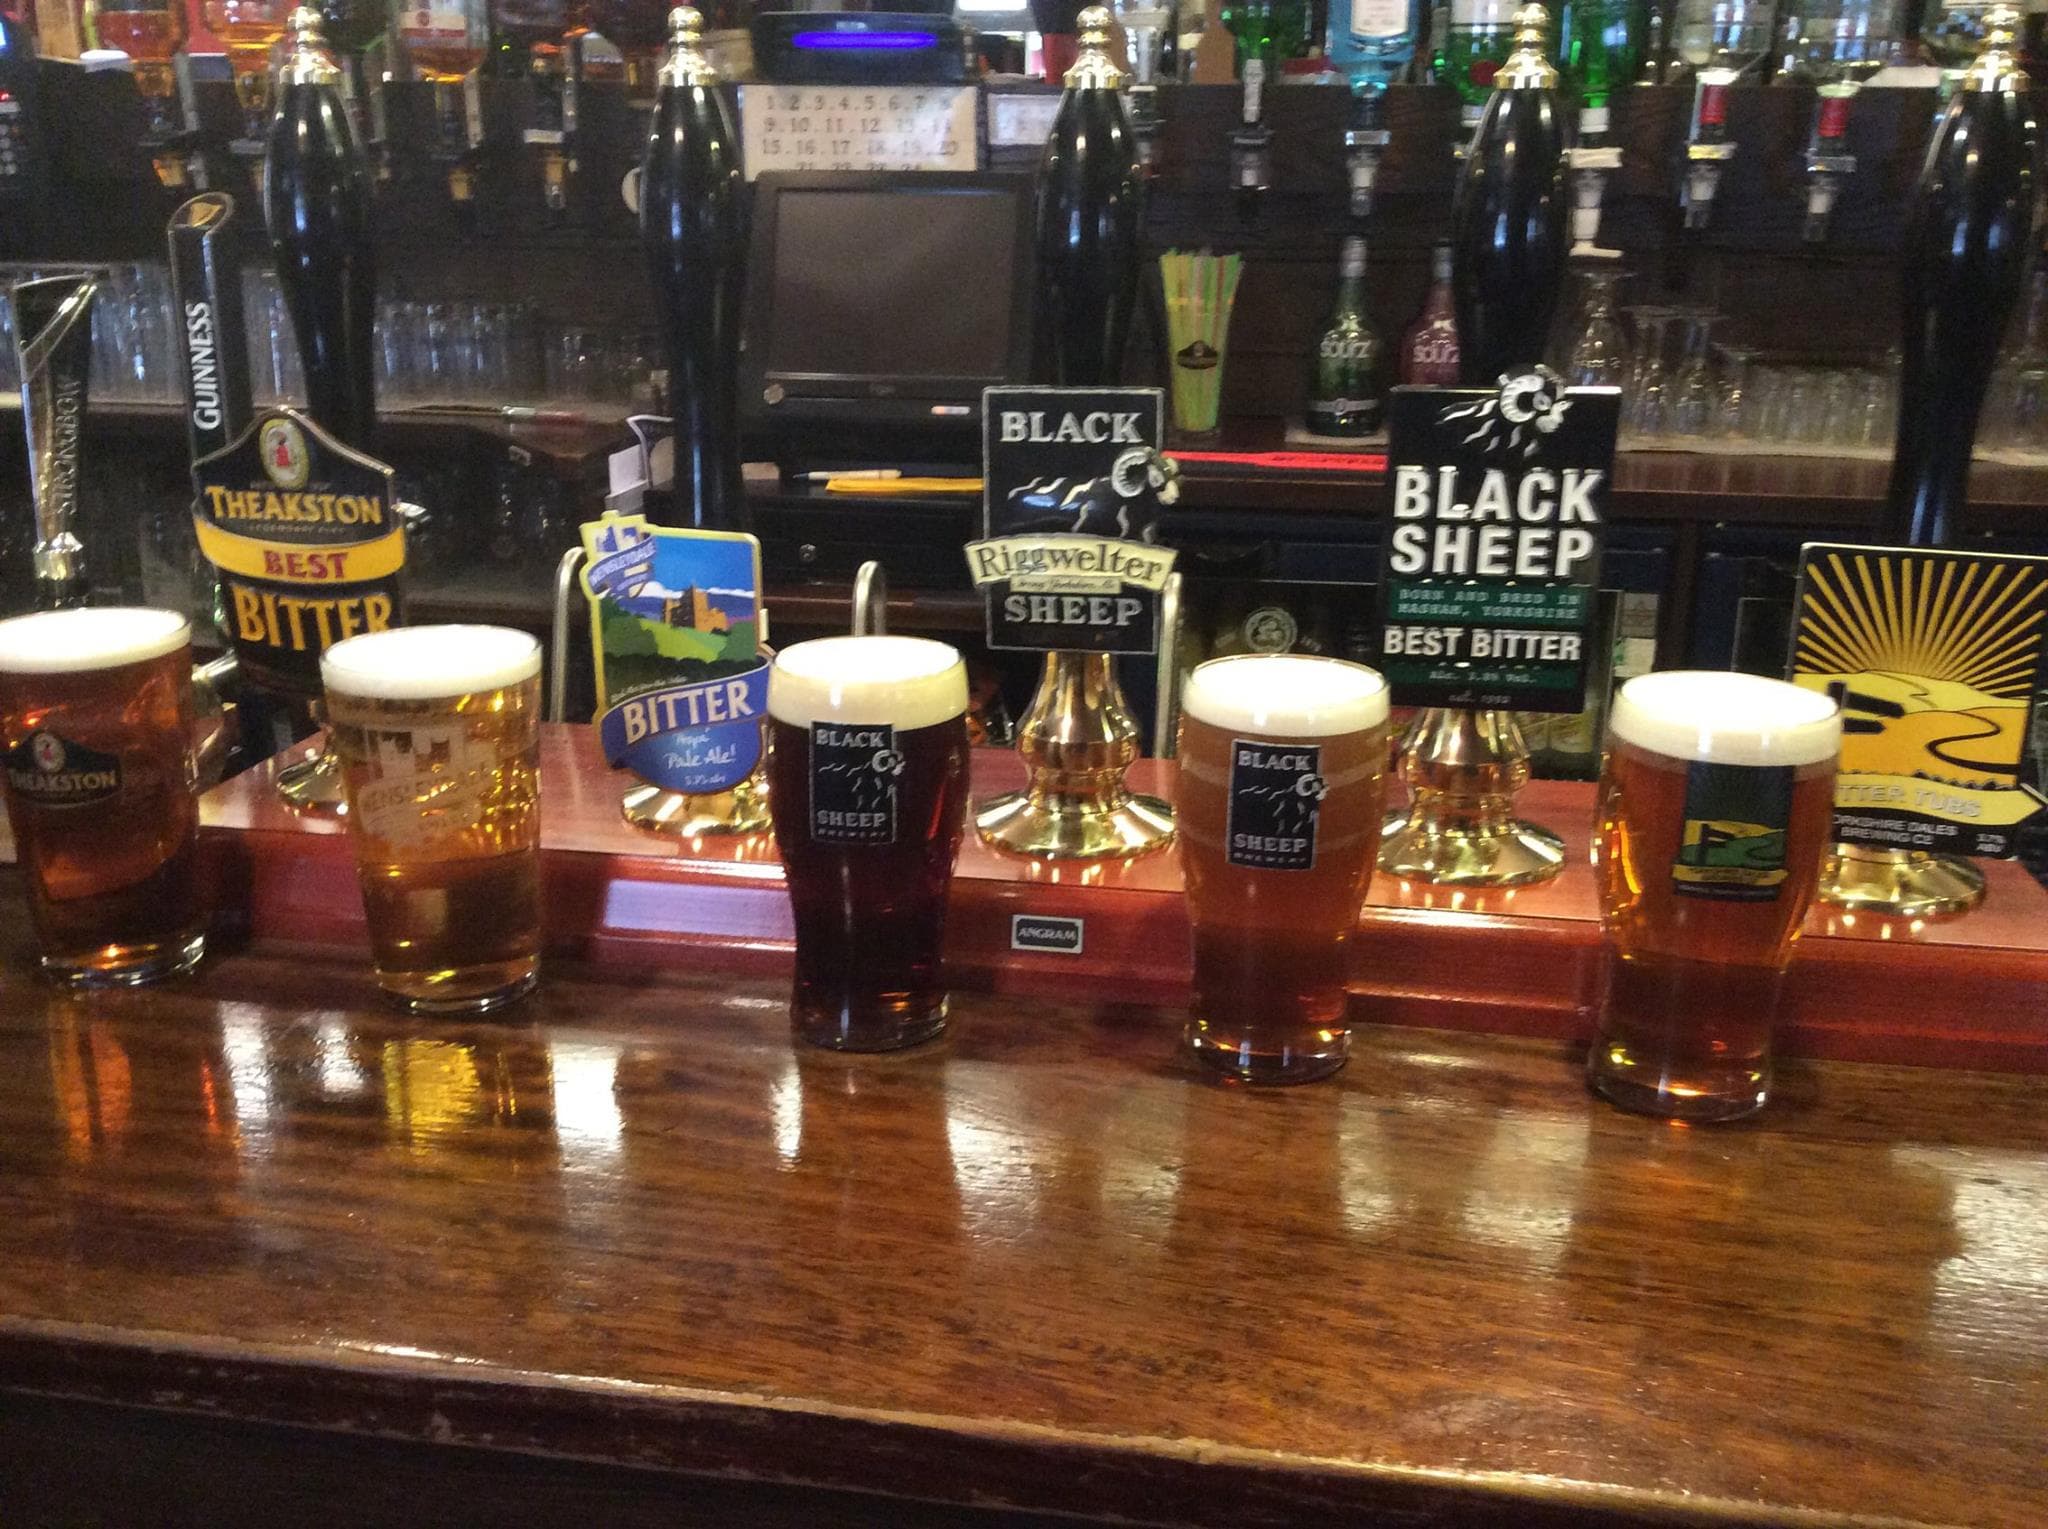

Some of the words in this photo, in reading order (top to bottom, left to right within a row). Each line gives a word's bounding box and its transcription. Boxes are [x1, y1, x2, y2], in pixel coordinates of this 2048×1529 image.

[185, 301, 222, 431] GUINNESS
[1000, 411, 1144, 443] BLACK
[204, 485, 382, 526] THEAKSTON
[1393, 464, 1605, 523] BLACK
[263, 550, 349, 579] BEST
[975, 543, 1163, 582] Riggwelter
[1390, 523, 1594, 578] SHEEP
[228, 582, 393, 652] BITTER
[1004, 594, 1143, 626] SHEEP
[1384, 625, 1465, 656] BEST
[1470, 628, 1582, 661] BITTER
[622, 680, 755, 745] BITTER
[815, 729, 885, 748] BLACK
[1238, 750, 1311, 771] BLACK
[817, 809, 886, 828] SHEEP
[1233, 833, 1307, 853] SHEEP
